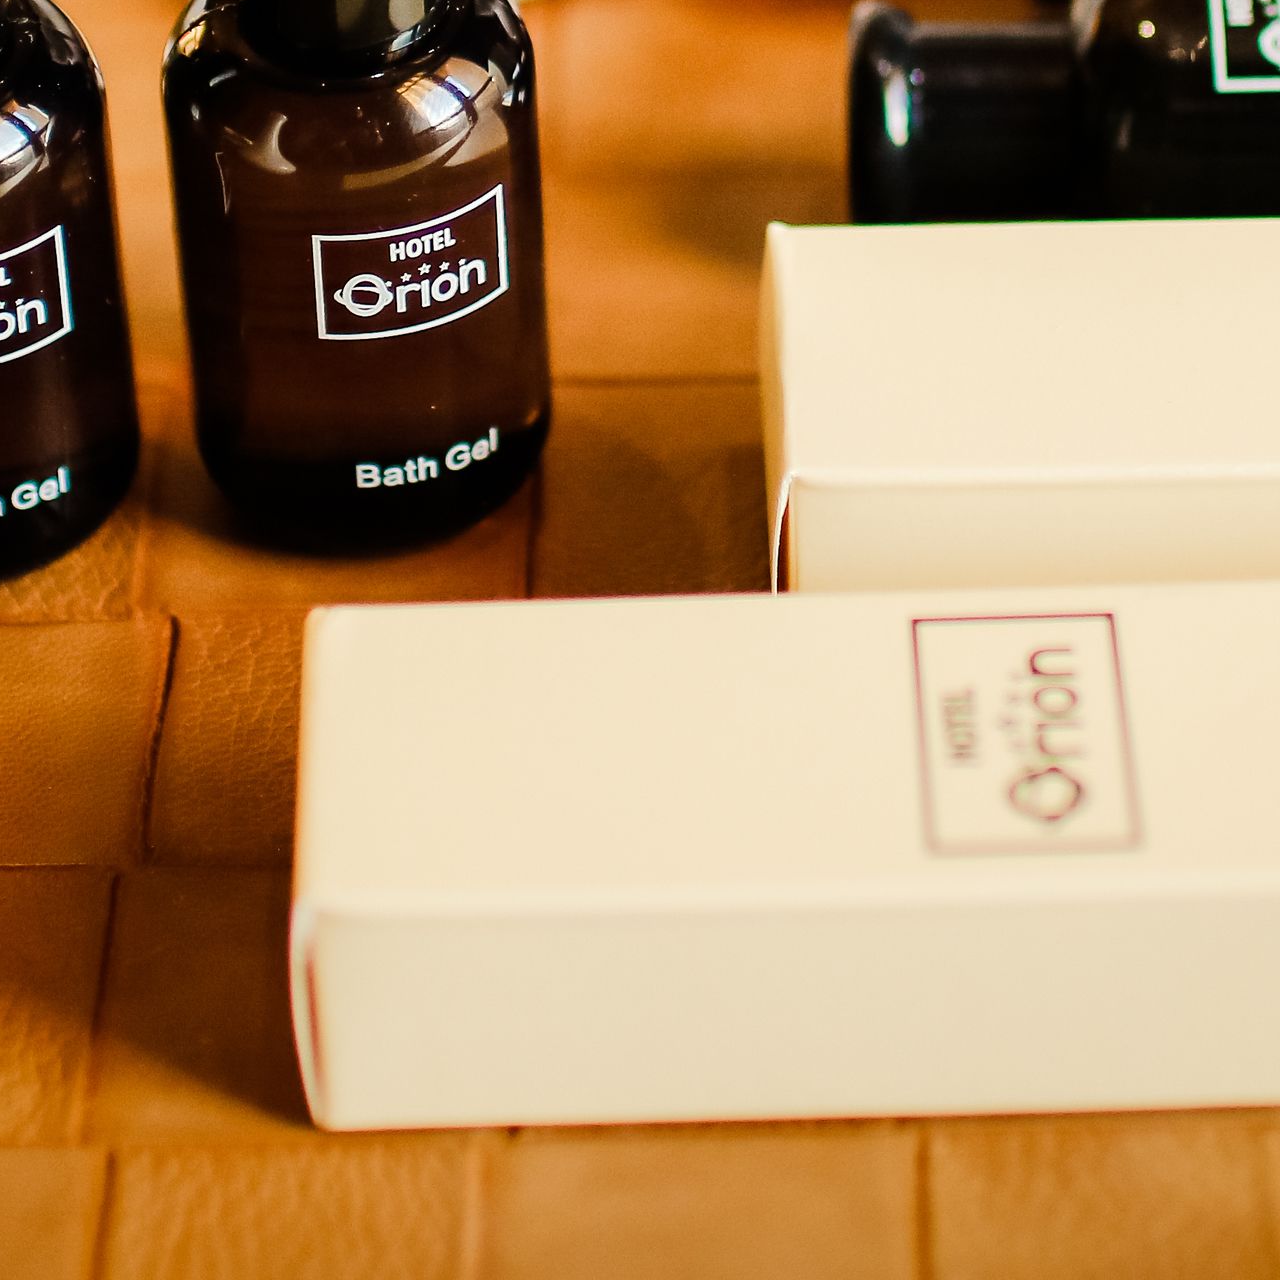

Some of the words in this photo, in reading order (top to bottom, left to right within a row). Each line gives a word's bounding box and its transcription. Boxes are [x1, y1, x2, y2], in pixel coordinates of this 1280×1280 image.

[389, 228, 456, 262] HOTEL
[334, 259, 487, 317] Orion
[355, 456, 439, 488] Bath
[445, 427, 498, 471] Gel
[11, 465, 70, 510] Gel
[1008, 645, 1086, 824] Orion
